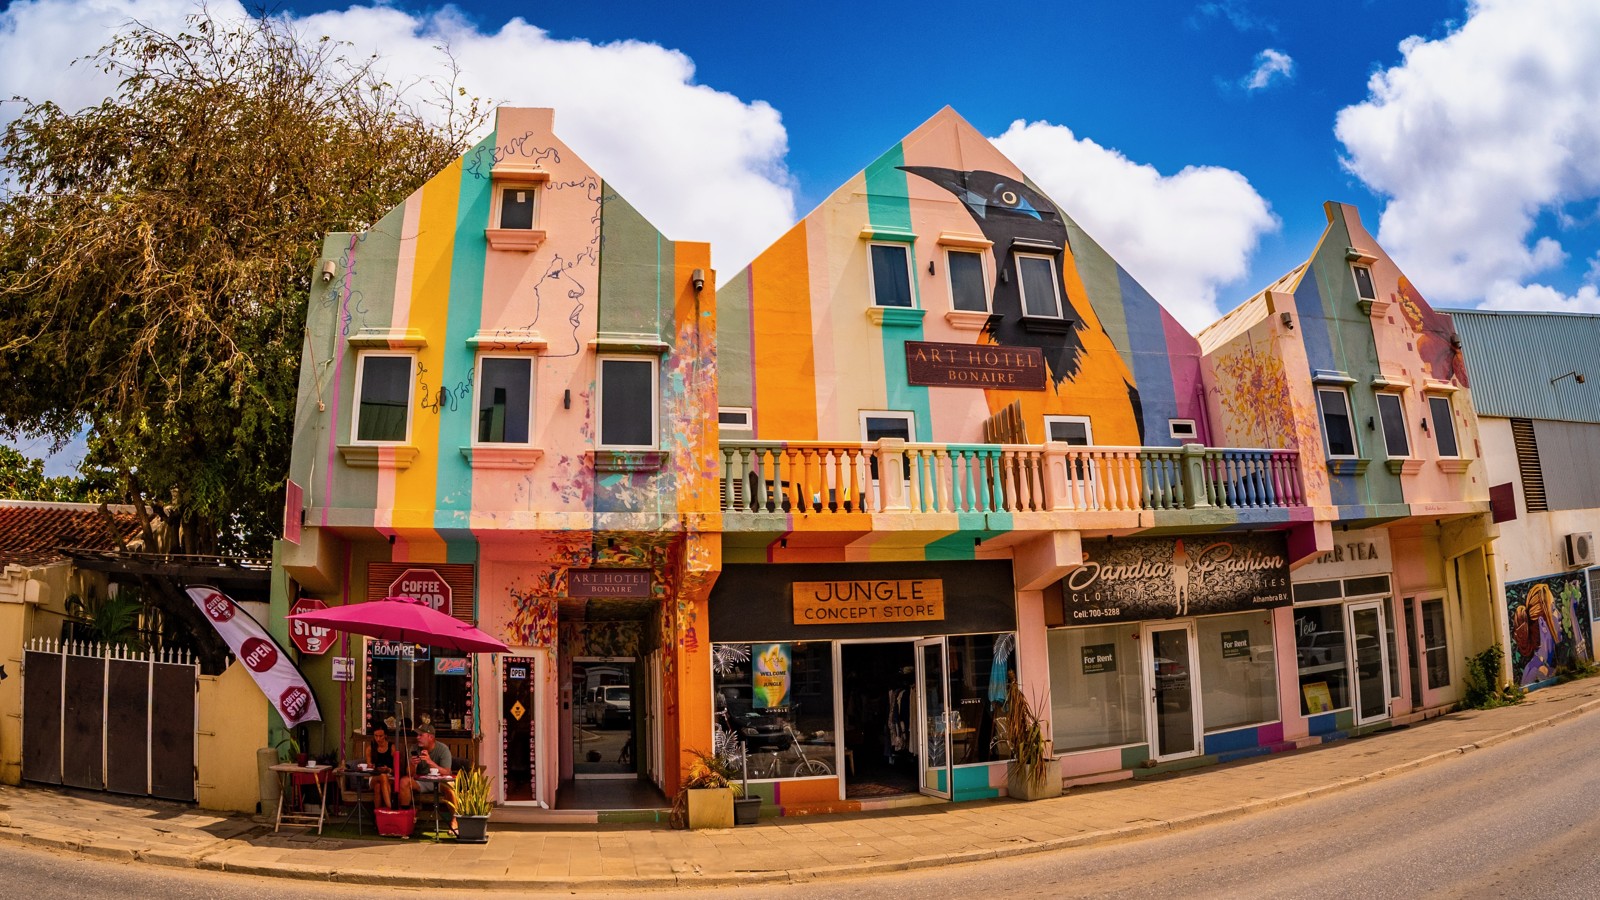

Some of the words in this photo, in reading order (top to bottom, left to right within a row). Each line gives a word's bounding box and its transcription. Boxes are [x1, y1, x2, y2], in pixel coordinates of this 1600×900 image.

[915, 348, 957, 363] ART
[969, 351, 1038, 368] HOTEL
[948, 370, 1016, 383] BONAIRE
[1347, 543, 1378, 561] TEA
[1068, 552, 1173, 591] Sandra
[1196, 541, 1284, 587] Fashion
[401, 580, 440, 593] COFFEE
[573, 574, 598, 583] ART
[604, 574, 647, 583] HOTEL
[591, 585, 632, 593] BONAIRE
[815, 581, 924, 602] JUNGLE
[206, 595, 222, 610] COFFEE
[399, 592, 445, 611] OP
[1253, 594, 1278, 603] Alhambra
[1278, 593, 1289, 601] B.V.
[210, 599, 231, 618] STOP
[804, 607, 877, 620] CONCEPT
[884, 604, 935, 618] STORE
[1295, 615, 1317, 637] Tea
[1223, 641, 1234, 649] For
[1234, 640, 1248, 648] Rent
[246, 642, 272, 668] OPEN
[1084, 656, 1096, 664] For
[1096, 653, 1113, 663] Rent
[511, 669, 525, 677] OPEN
[283, 688, 301, 707] COFFEE
[287, 692, 307, 717] STOP
